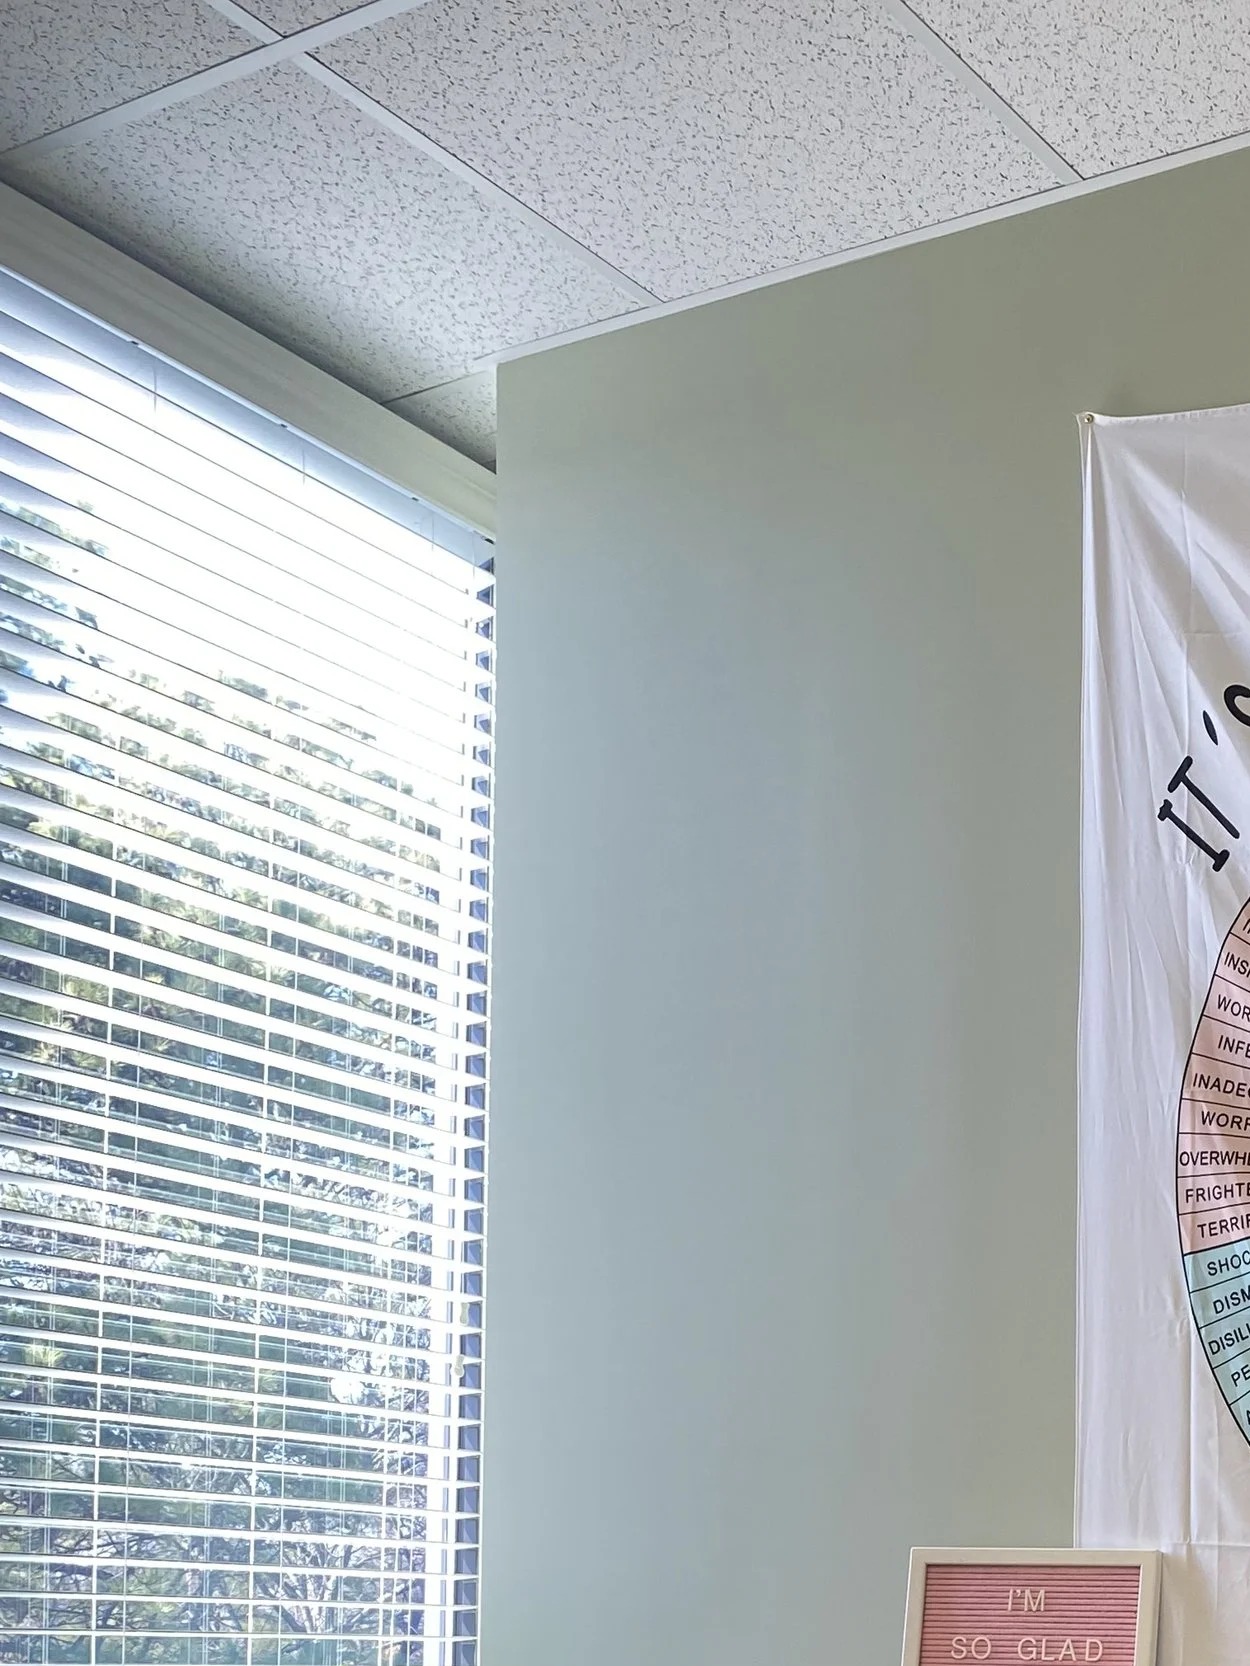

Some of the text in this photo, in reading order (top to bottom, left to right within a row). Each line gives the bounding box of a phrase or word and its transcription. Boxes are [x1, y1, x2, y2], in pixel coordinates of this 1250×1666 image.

[1007, 1588, 1045, 1612] I'M
[950, 1636, 1103, 1662] SO GLAD
